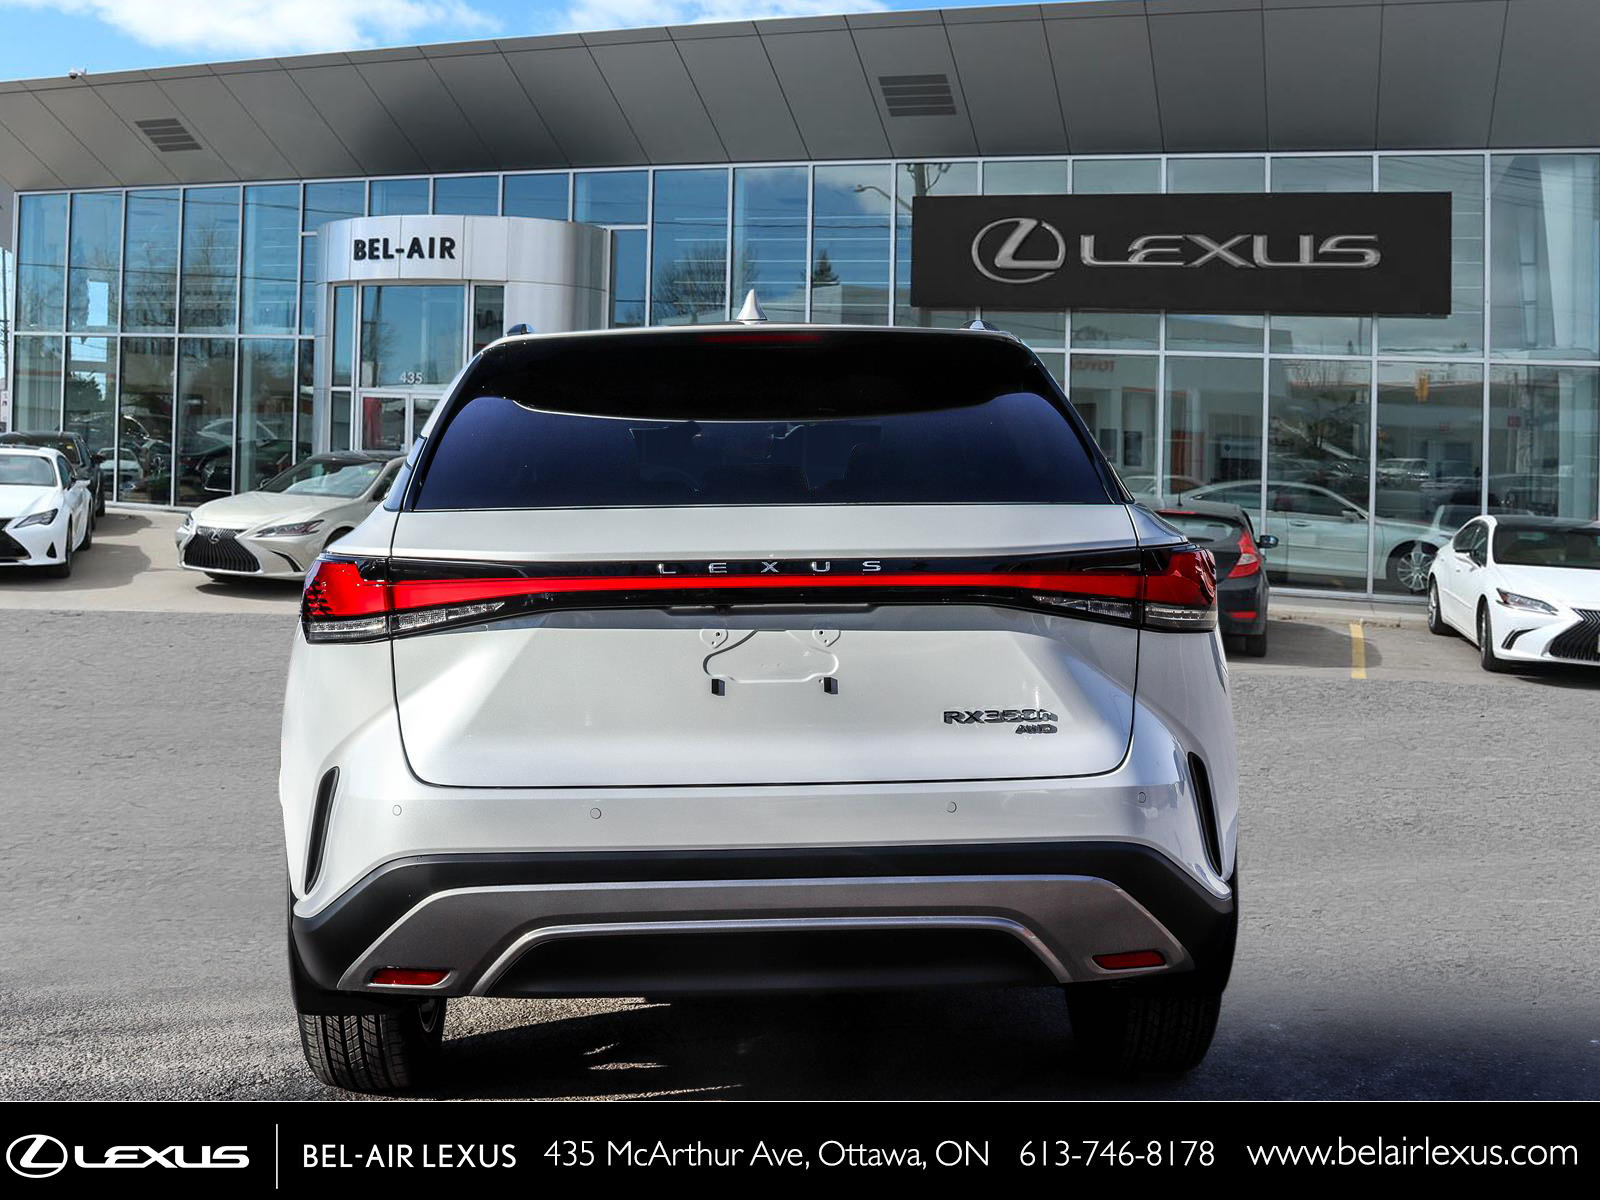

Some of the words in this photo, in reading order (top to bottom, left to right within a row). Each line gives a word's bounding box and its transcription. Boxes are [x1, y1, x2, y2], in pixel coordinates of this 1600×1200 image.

[353, 236, 456, 261] BEL-AIR
[1080, 234, 1381, 268] LEXUS
[399, 371, 423, 384] 435
[657, 559, 882, 575] LEXUS
[1015, 723, 1058, 734] AWD
